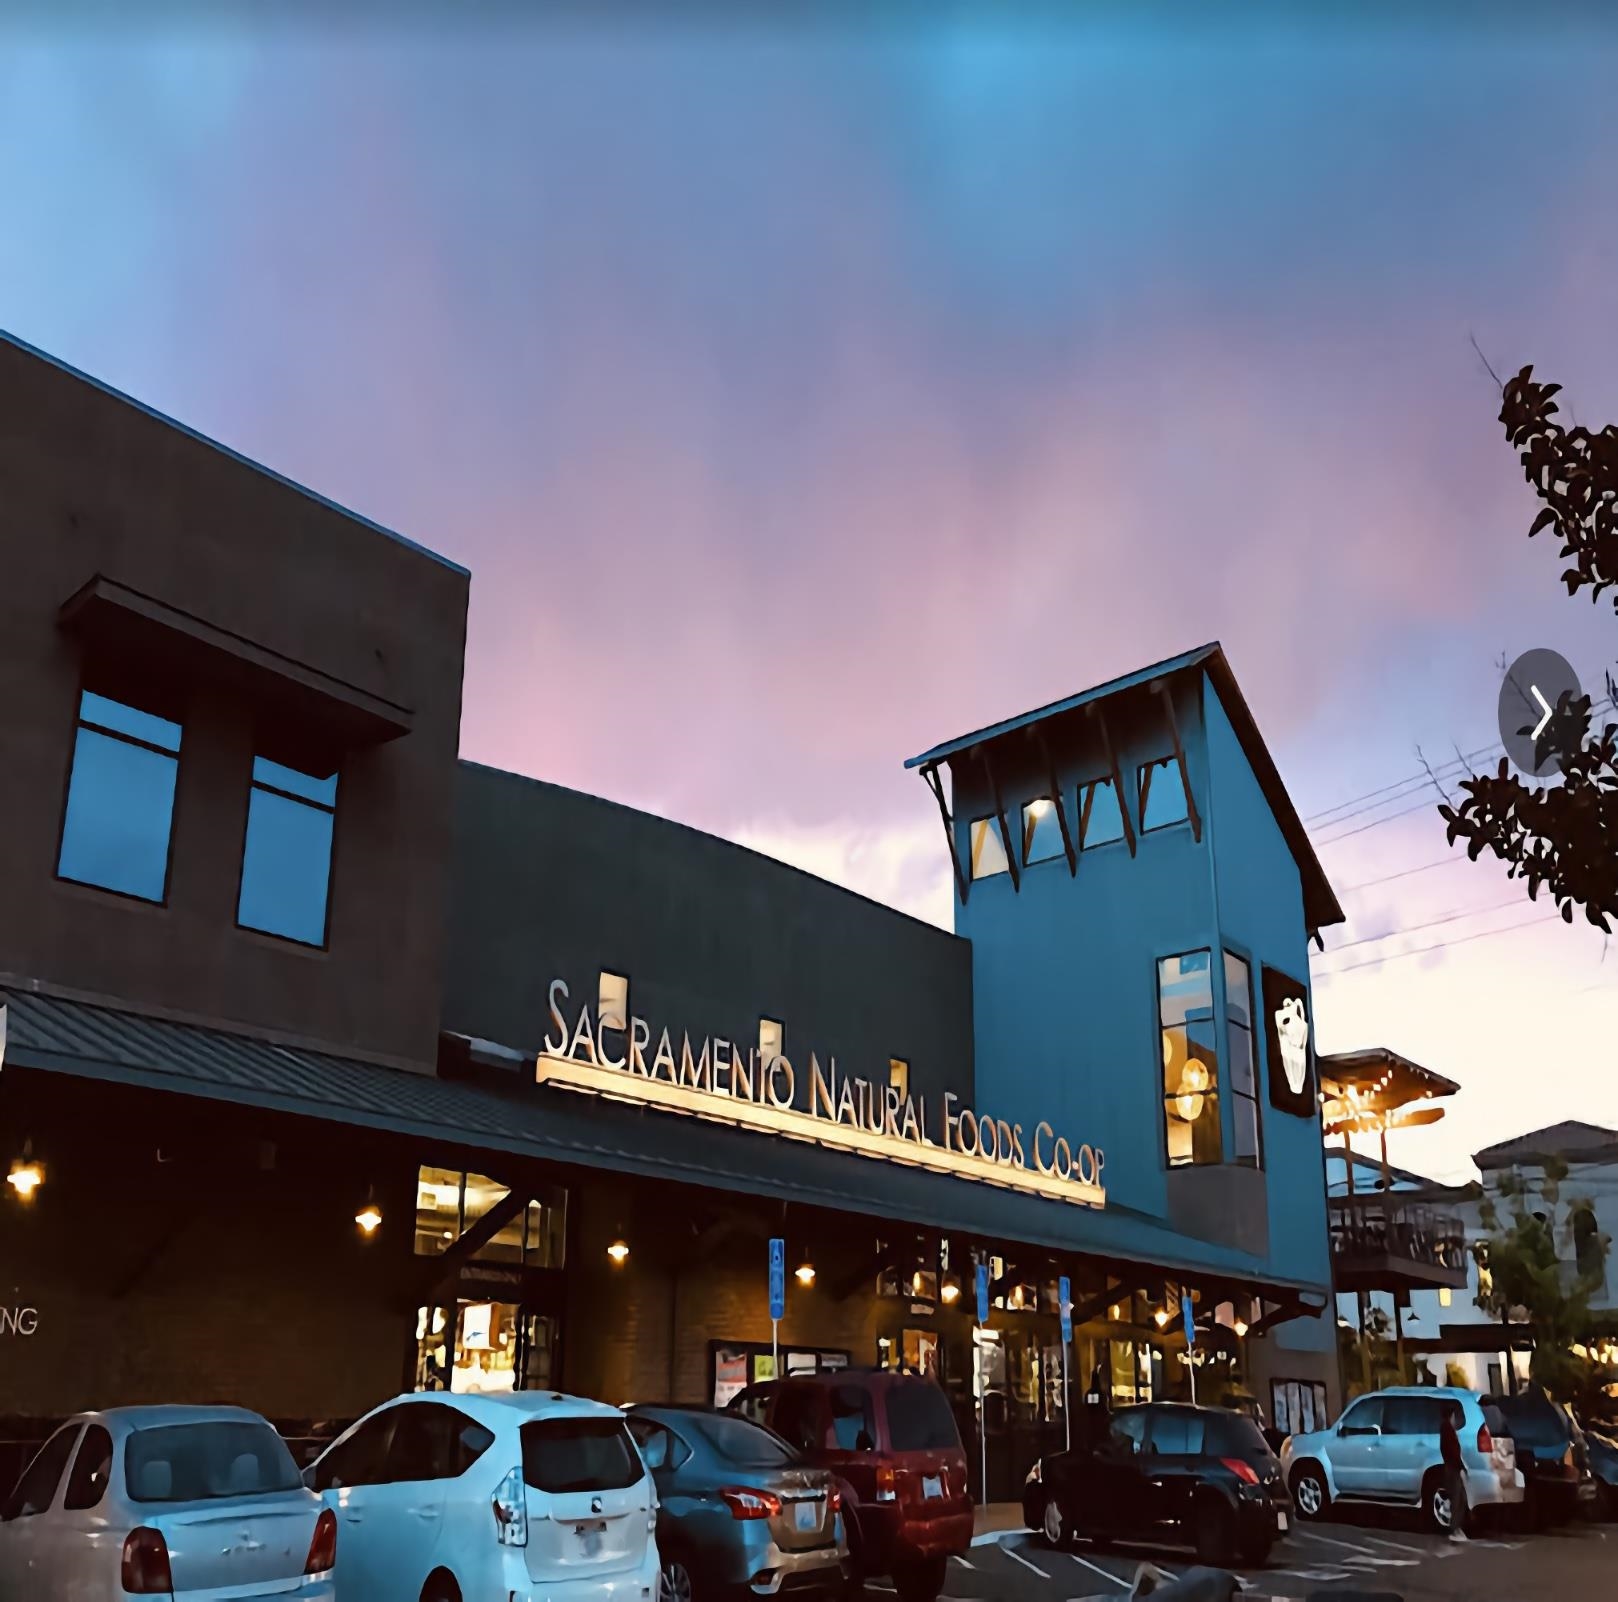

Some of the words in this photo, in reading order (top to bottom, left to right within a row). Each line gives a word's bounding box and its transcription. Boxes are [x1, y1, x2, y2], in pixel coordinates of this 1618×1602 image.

[544, 979, 795, 1110] SACRAMENTO
[809, 1051, 934, 1147] NATURAL
[944, 1091, 1025, 1169] FOODS
[1034, 1121, 1105, 1188] CO-OP
